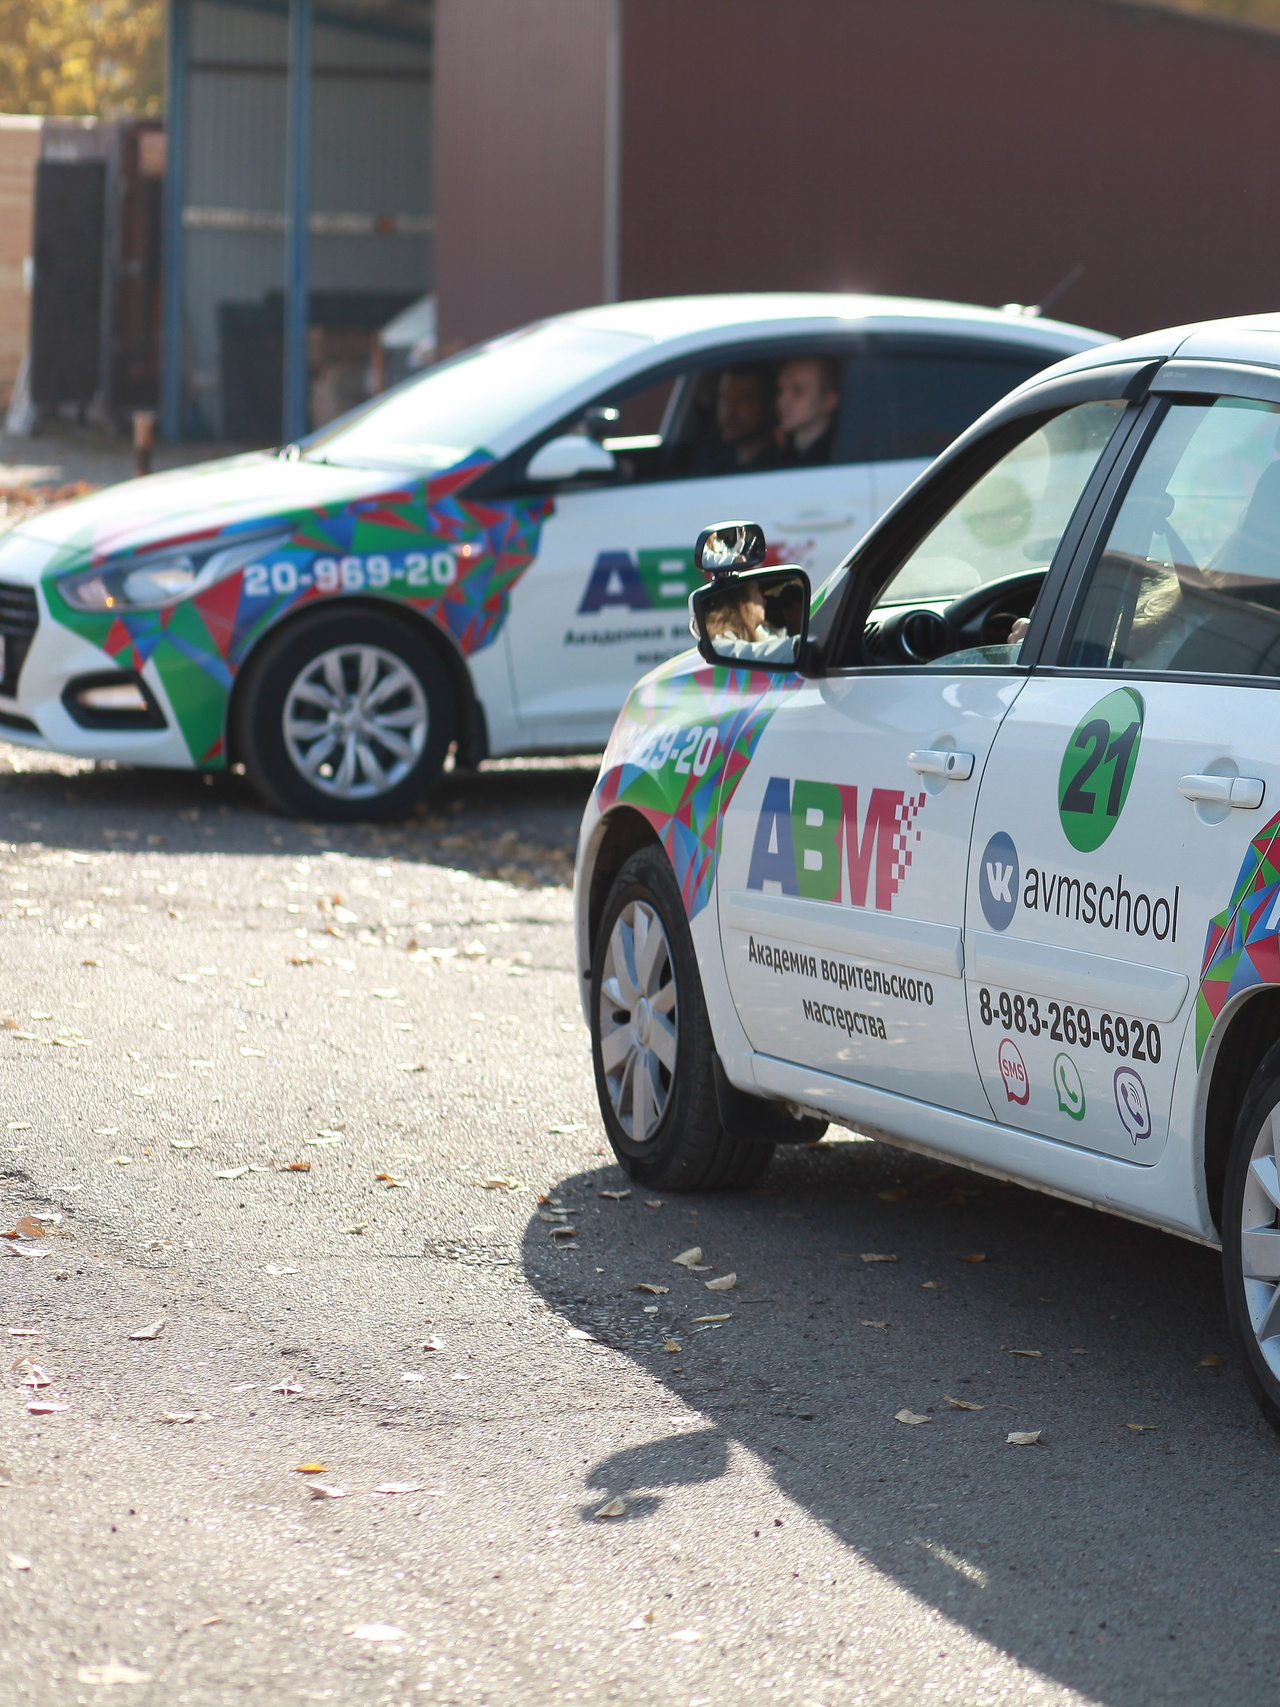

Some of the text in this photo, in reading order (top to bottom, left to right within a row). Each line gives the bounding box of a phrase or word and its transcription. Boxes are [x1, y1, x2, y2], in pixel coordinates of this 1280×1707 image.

[243, 552, 458, 597] 20-969-20
[1059, 718, 1142, 817] 21
[1023, 867, 1180, 943] avmschool
[748, 935, 934, 1006] Академия водительского
[802, 998, 888, 1040] мастерства
[979, 987, 1162, 1064] 8-983-269-6920
[1002, 1059, 1025, 1082] SMS
